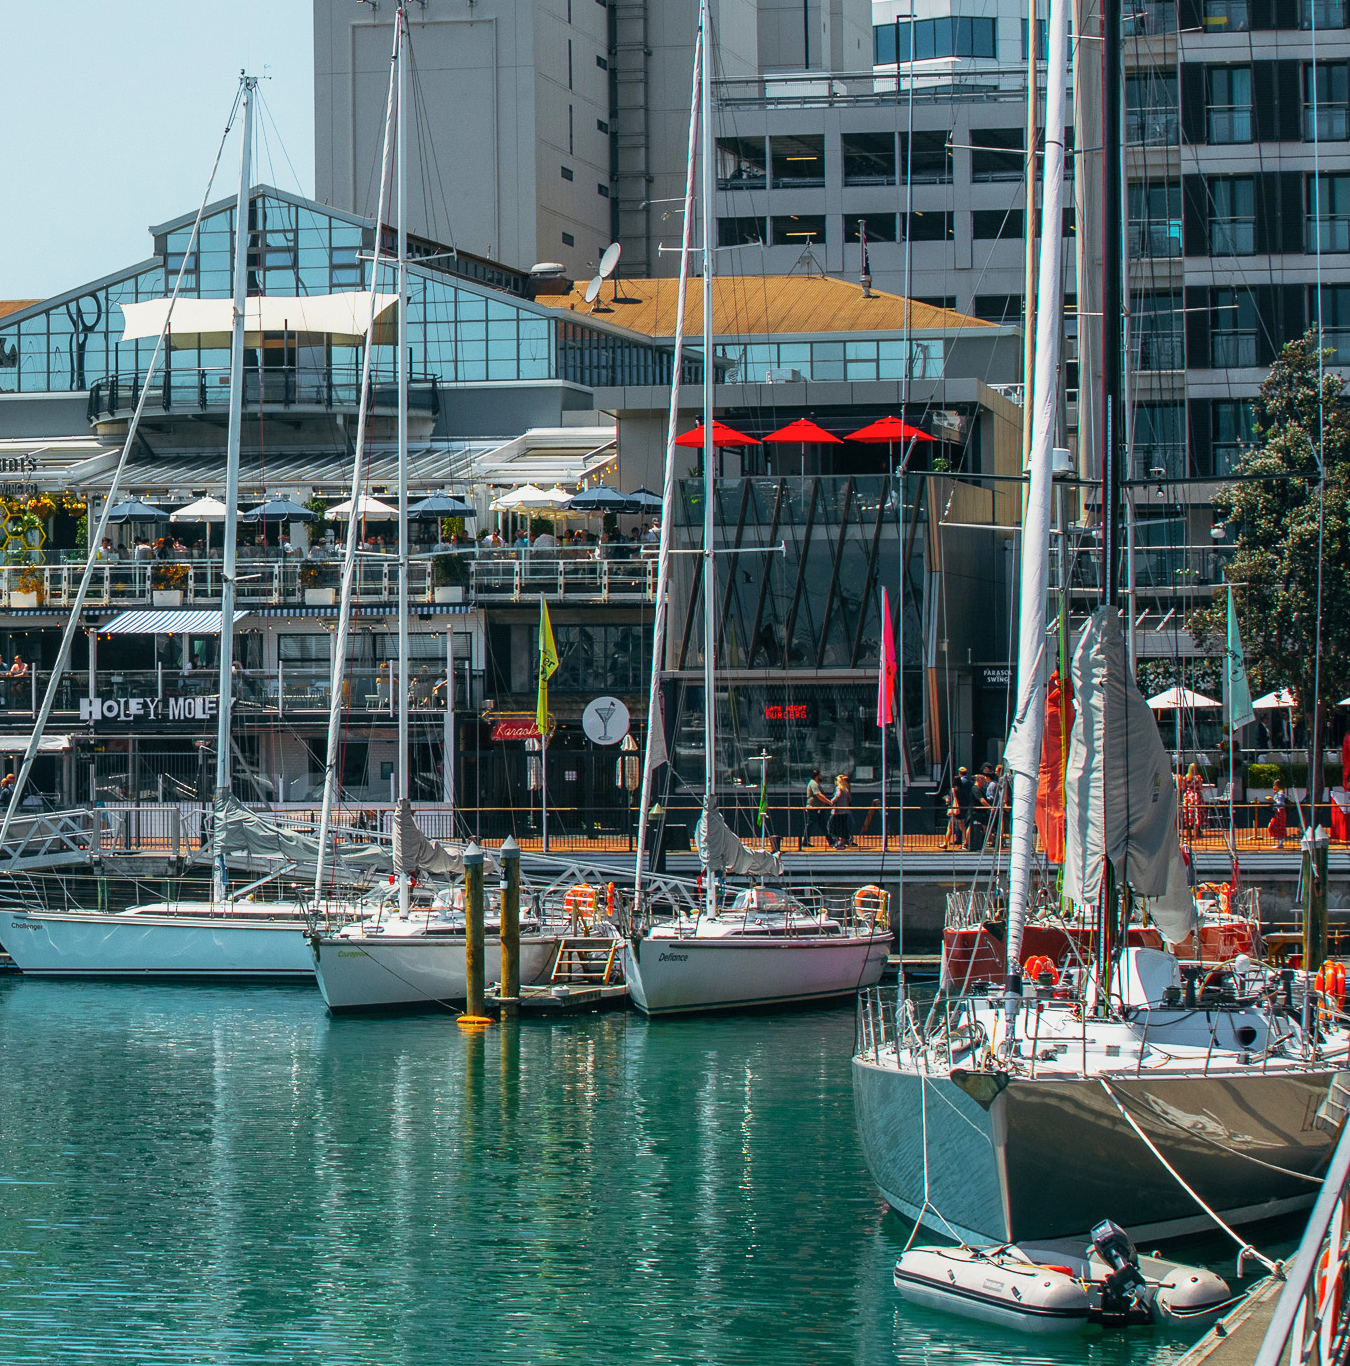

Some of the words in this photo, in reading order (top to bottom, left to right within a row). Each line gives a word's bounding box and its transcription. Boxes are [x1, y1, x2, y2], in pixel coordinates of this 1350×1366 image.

[765, 711, 807, 719] BURGERS
[11, 922, 43, 931] Challenger
[658, 952, 689, 961] Defiance
